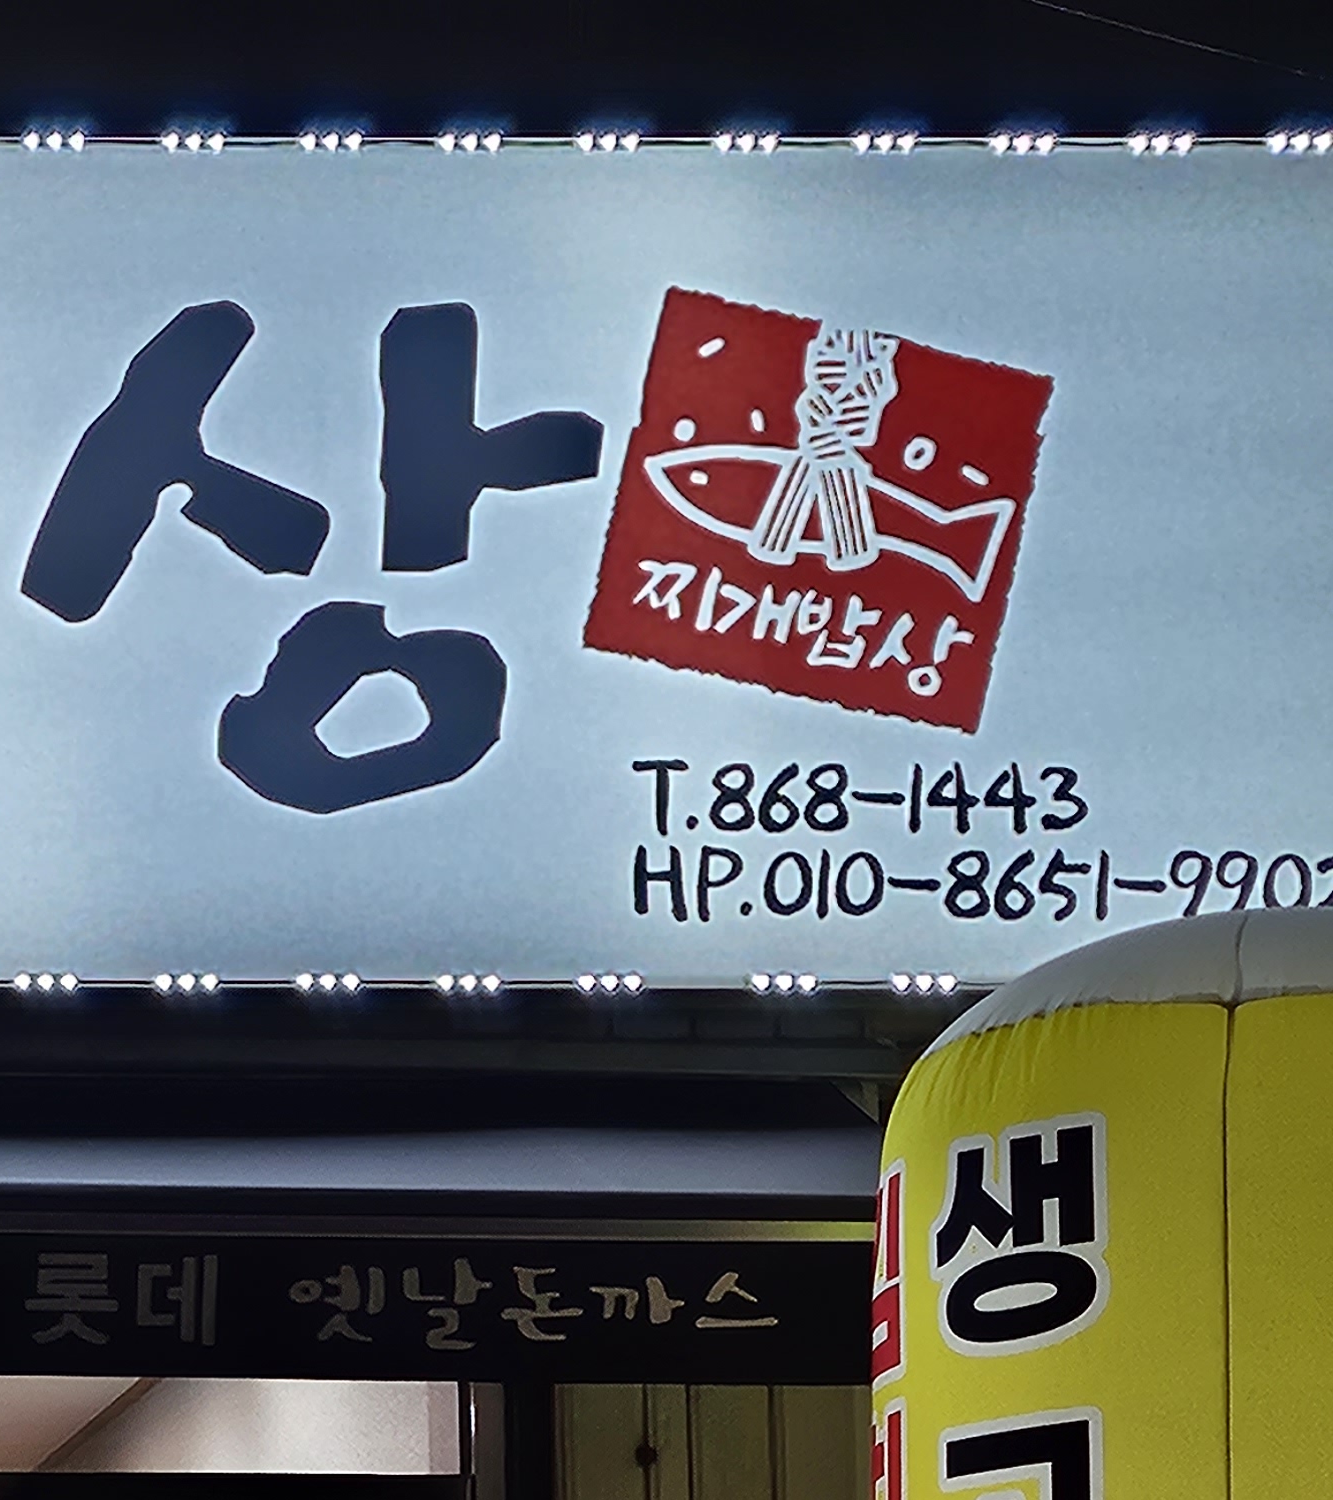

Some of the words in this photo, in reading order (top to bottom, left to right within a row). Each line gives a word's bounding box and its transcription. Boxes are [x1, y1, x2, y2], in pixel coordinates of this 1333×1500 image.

[633, 557, 975, 697] 찌개밥상
[633, 760, 1089, 837] T.868-1443
[23, 1252, 220, 1346] 롯데
[287, 1255, 779, 1351] 옛날돈까스
